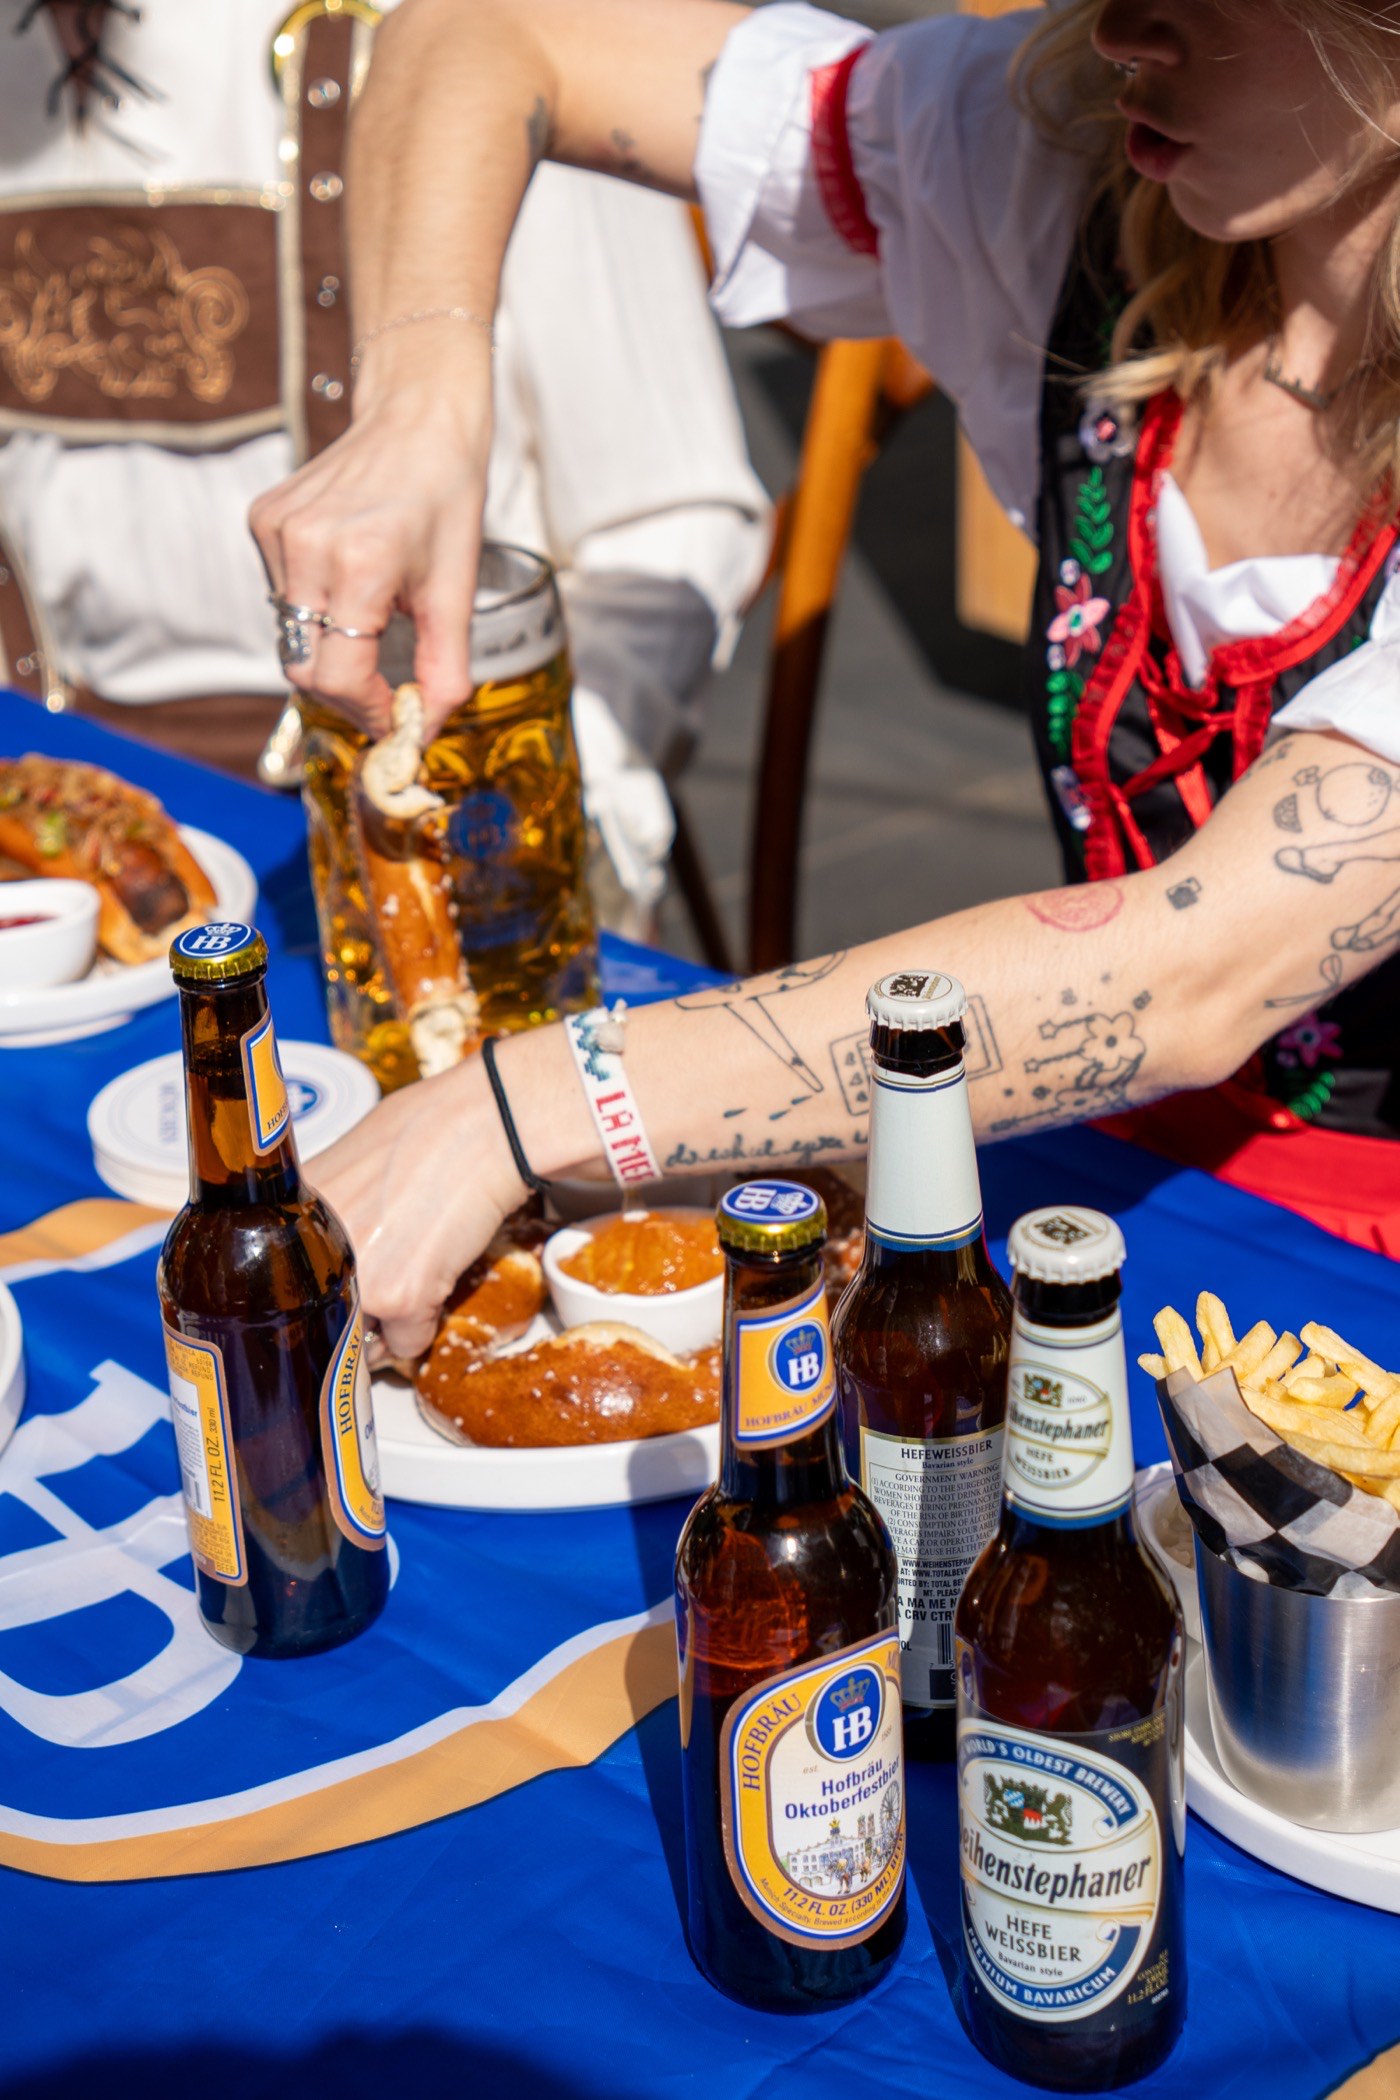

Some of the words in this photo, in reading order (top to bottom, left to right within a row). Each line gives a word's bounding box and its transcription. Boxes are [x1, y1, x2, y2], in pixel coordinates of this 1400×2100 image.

[188, 935, 232, 950] HB
[595, 1090, 633, 1131] LA
[734, 1186, 778, 1211] HB
[788, 1352, 820, 1387] HB
[901, 1440, 993, 1460] HEFEWEISSBIER
[922, 1461, 955, 1470] Bavarian
[957, 1457, 974, 1467] style
[880, 1480, 925, 1493] ACCORDING
[926, 1485, 938, 1493] TO
[940, 1484, 956, 1493] THE
[957, 1476, 990, 1491] SURGEON
[895, 1473, 957, 1483] GOVERNMENT
[874, 1486, 903, 1500] WOMEN
[903, 1493, 936, 1502] SHOULD
[938, 1494, 957, 1502] NOT
[957, 1489, 981, 1500] DRINK
[874, 1495, 914, 1510] BEVERAGES
[915, 1503, 947, 1512] DURING
[948, 1493, 992, 1510] PREGNANCY
[890, 1509, 901, 1517] OF
[902, 1511, 919, 1519] THE
[919, 1512, 937, 1520] RISK
[938, 1511, 949, 1520] OF
[950, 1508, 974, 1519] BIRTH
[897, 1518, 956, 1529] CONSUMPTION
[958, 1517, 969, 1527] OF
[909, 1537, 925, 1547] CAR
[926, 1539, 938, 1547] OR
[939, 1535, 975, 1547] OPERATE
[924, 1529, 956, 1538] IMPAIRS
[956, 1525, 977, 1536] YOUR
[901, 1545, 918, 1555] MAY
[918, 1547, 945, 1556] CAUSE
[945, 1543, 977, 1555] HEALTH
[900, 1567, 911, 1576] AT:
[918, 1579, 930, 1588] BY:
[931, 1580, 951, 1588] TOTAL
[923, 1589, 935, 1597] MT.
[907, 1597, 926, 1609] MA
[928, 1599, 947, 1610] ME
[905, 1609, 927, 1621] CRV
[832, 1705, 873, 1752] HB
[742, 1693, 802, 1792] HOFBRÄU
[784, 1754, 900, 1820] Oktoberfestbier
[821, 1758, 883, 1797] Hofbräu
[1011, 1745, 1075, 1775] OLDEST
[1074, 1766, 1132, 1816] BREWERY
[783, 1887, 809, 1909] 11.2
[808, 1901, 825, 1916] FL.
[829, 1903, 849, 1917] OZ.
[851, 1891, 873, 1913] (330
[874, 1870, 891, 1896] ML)
[813, 1917, 842, 1926] Brewed
[843, 1905, 876, 1924] according
[1006, 1913, 1053, 1940] HEFE
[985, 1920, 1083, 1963] WEISSBIER
[967, 1926, 1018, 1996] PREMIUM
[1023, 1965, 1117, 2005] BAVARICUM
[998, 1951, 1037, 1973] Bavarian
[1039, 1966, 1064, 1978] style
